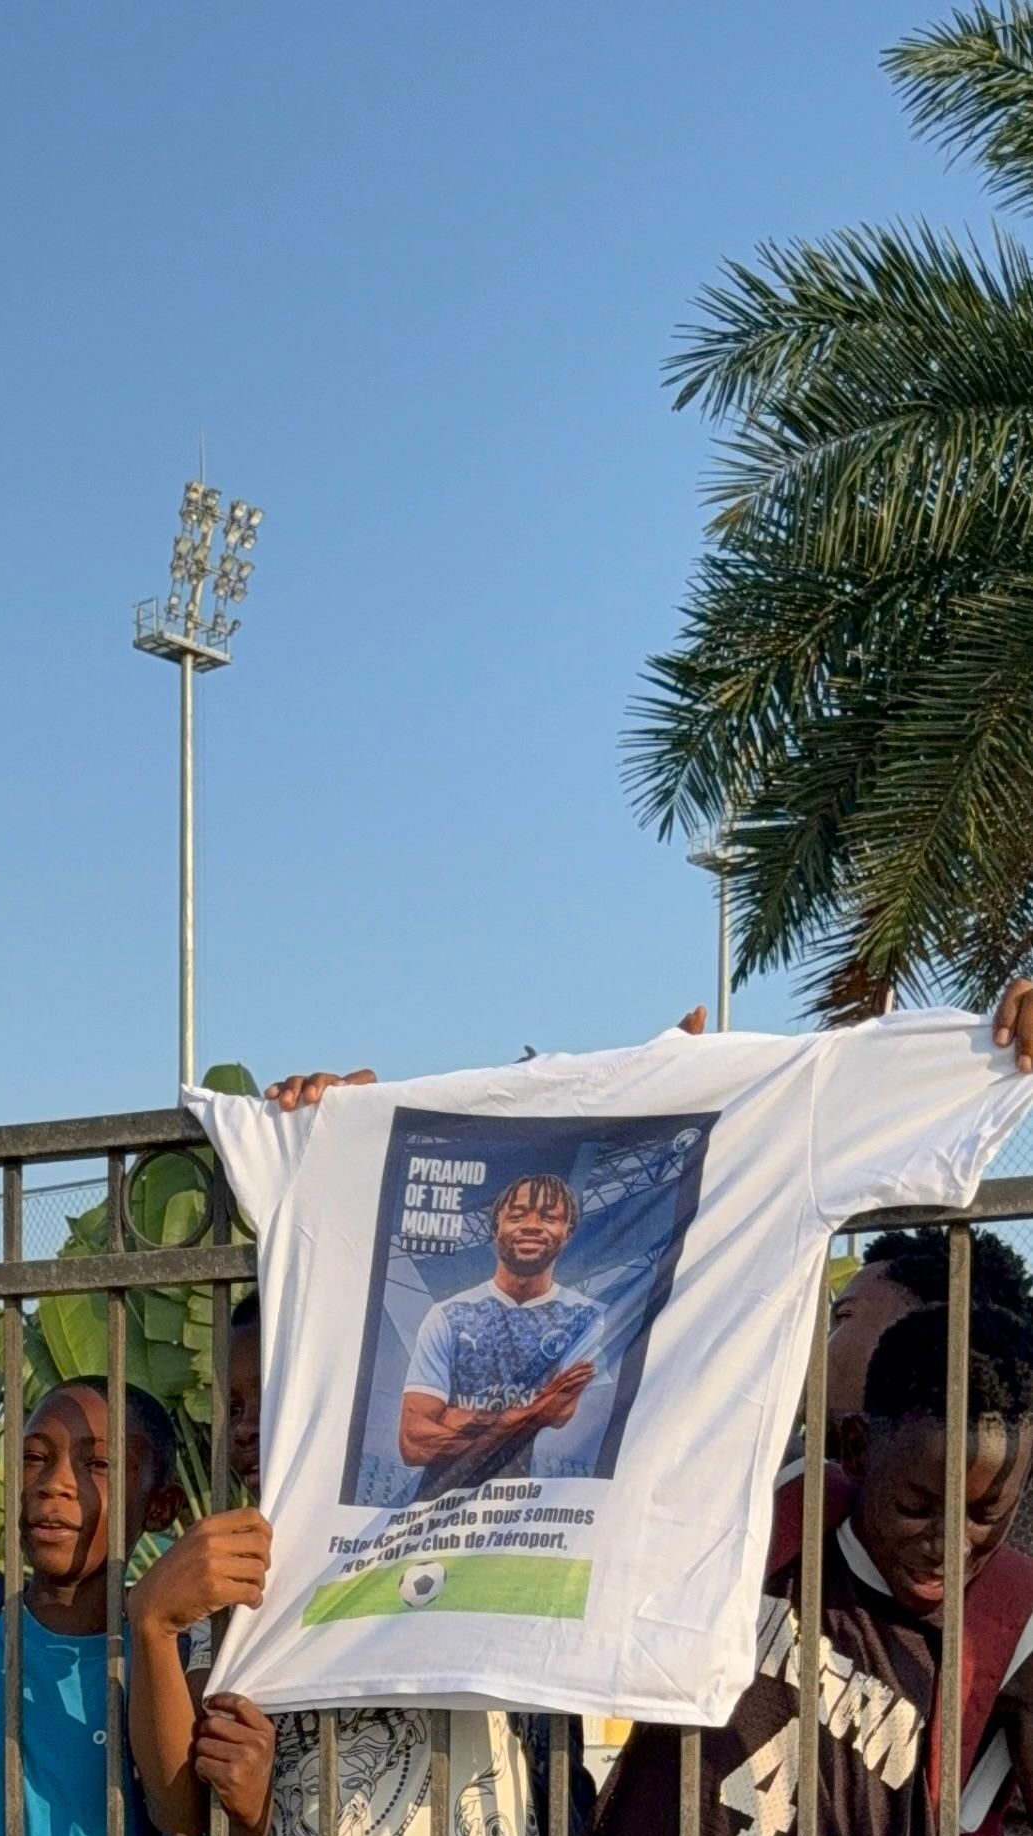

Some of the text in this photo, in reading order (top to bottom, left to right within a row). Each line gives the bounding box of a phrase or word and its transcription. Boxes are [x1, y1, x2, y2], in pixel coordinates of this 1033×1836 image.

[408, 1157, 487, 1185] PYRAMID
[405, 1184, 464, 1210] OF THE
[402, 1209, 464, 1237] MONTH
[402, 1240, 455, 1254] AUGUST
[481, 1482, 543, 1501] Angola
[481, 1507, 523, 1525] nous
[523, 1507, 595, 1525] sommes
[421, 1532, 461, 1551] club
[465, 1531, 485, 1549] de
[486, 1529, 568, 1551] l'aéroport,
